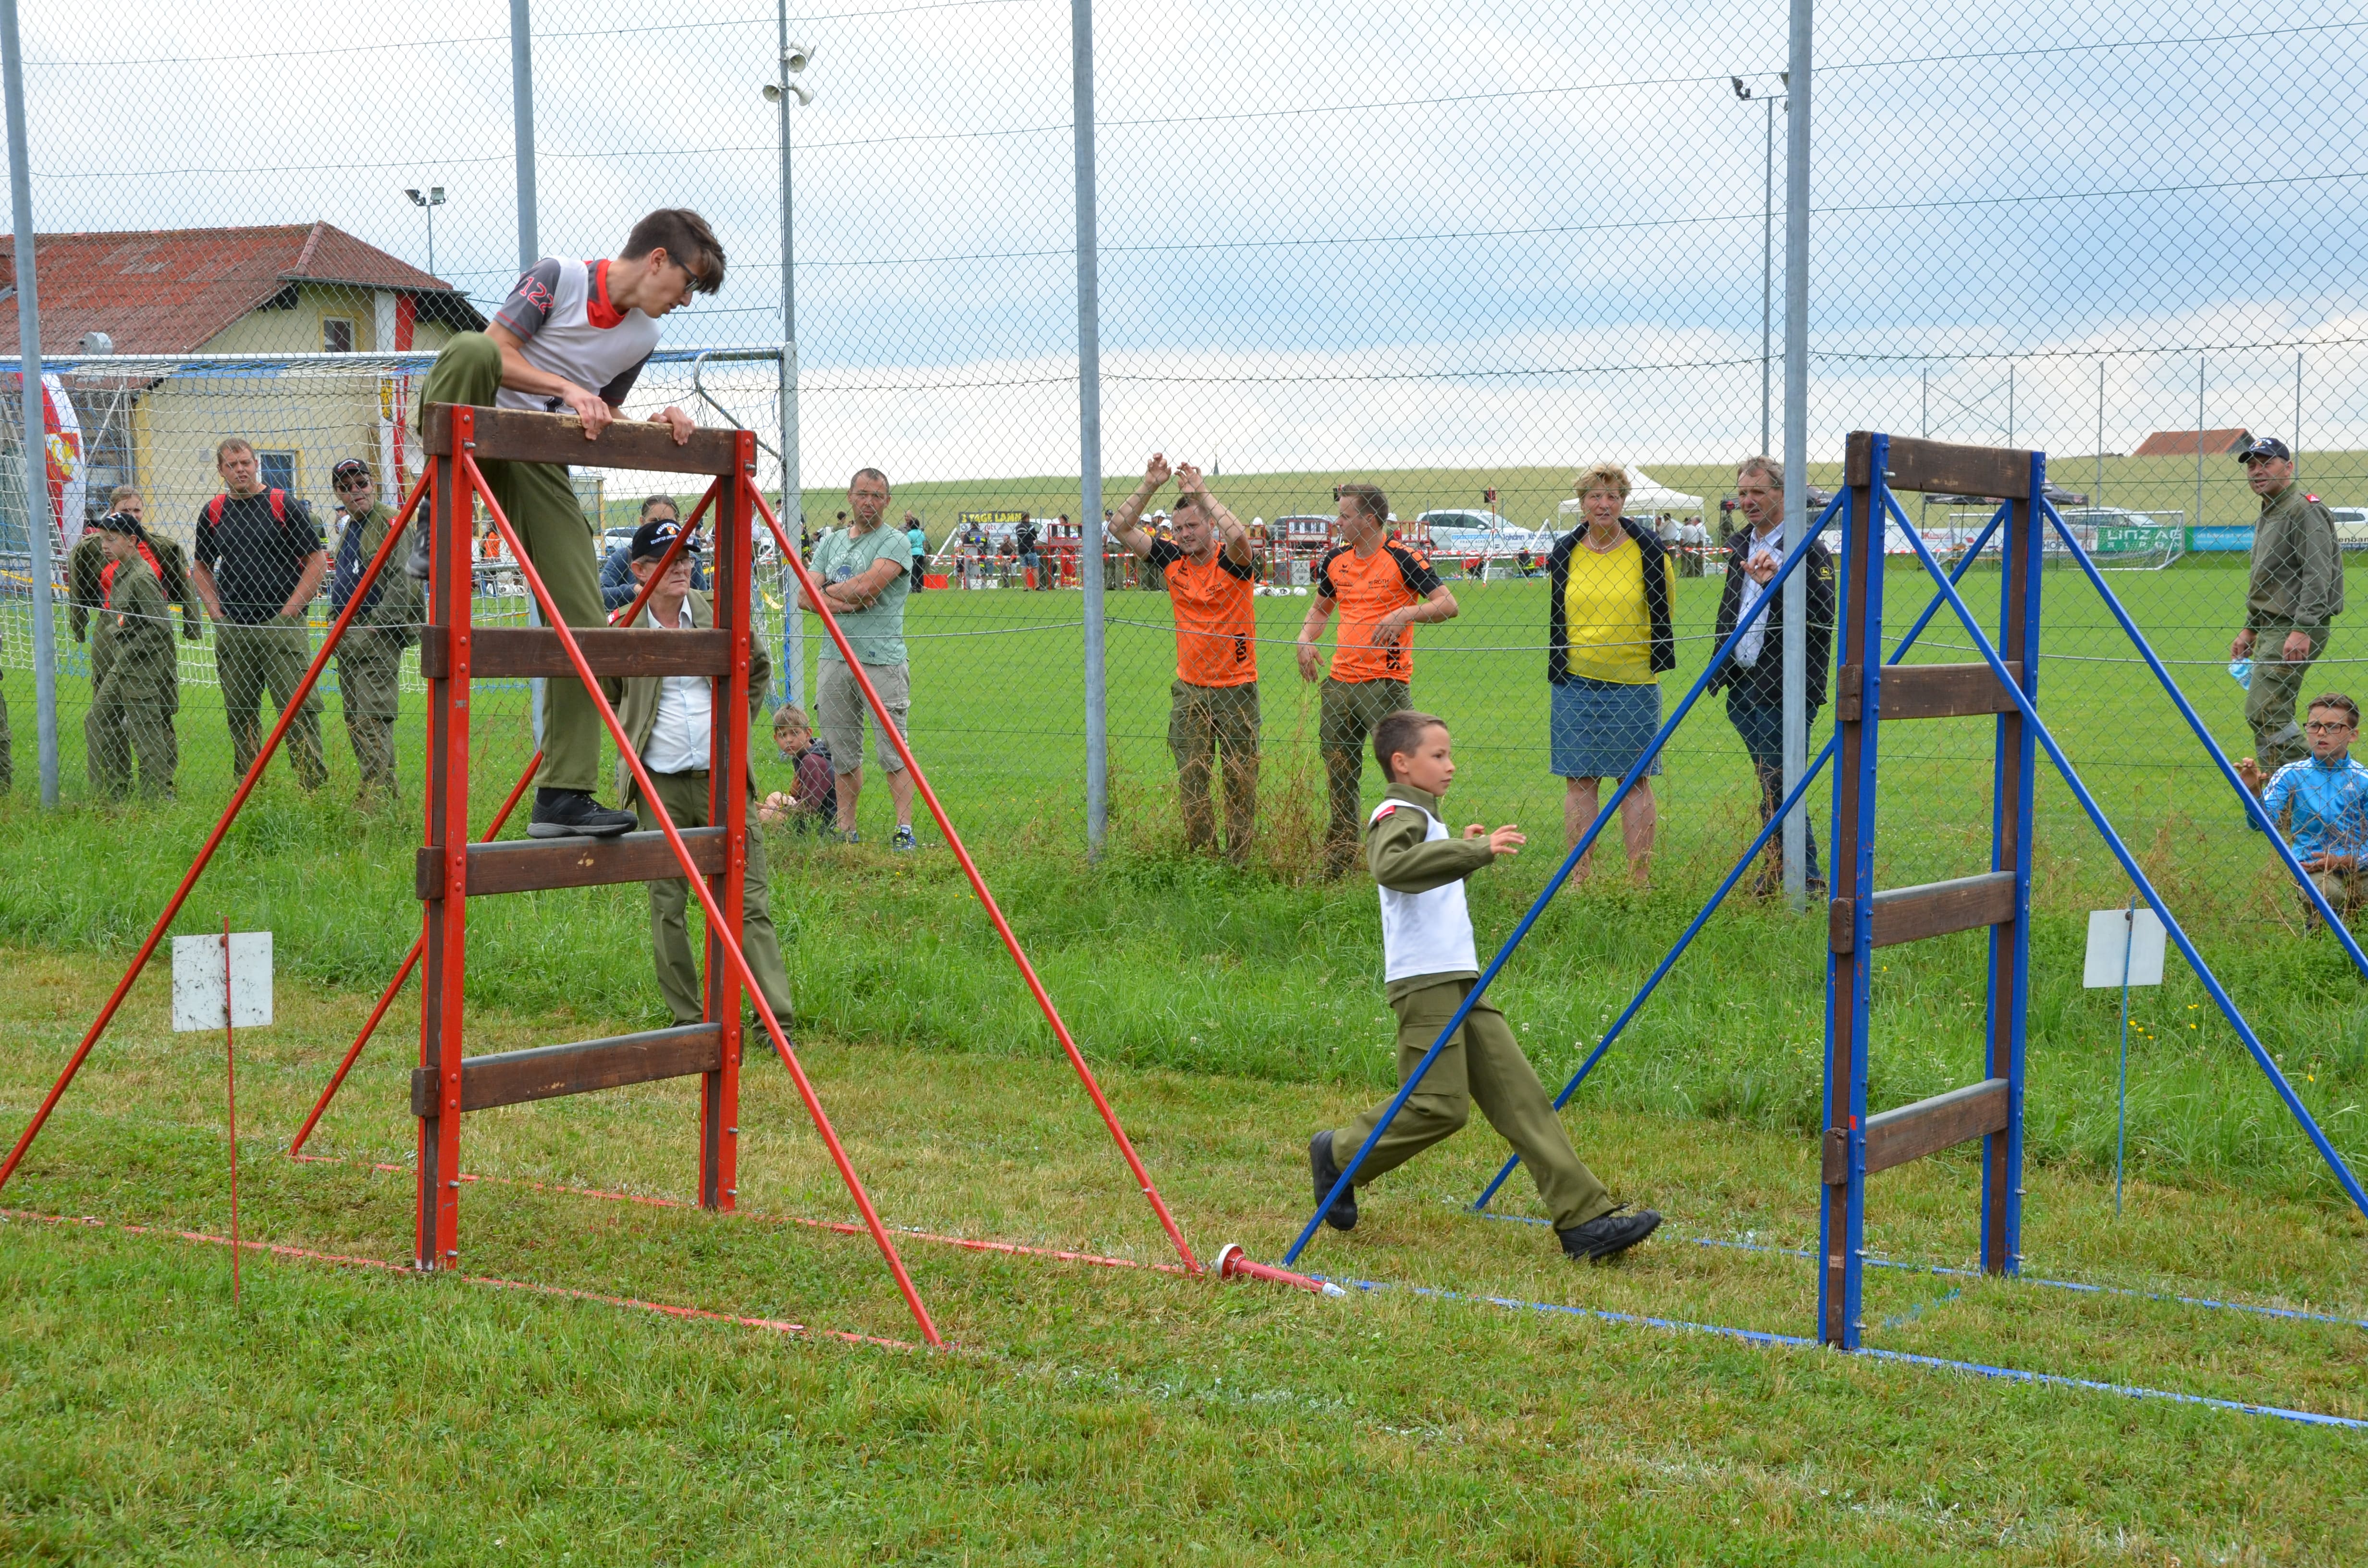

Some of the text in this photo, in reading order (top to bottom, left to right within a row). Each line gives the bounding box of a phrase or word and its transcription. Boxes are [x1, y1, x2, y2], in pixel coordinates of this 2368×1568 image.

[519, 276, 554, 315] 122
[969, 513, 993, 523] TAGE
[656, 522, 681, 534] FEUERWEH
